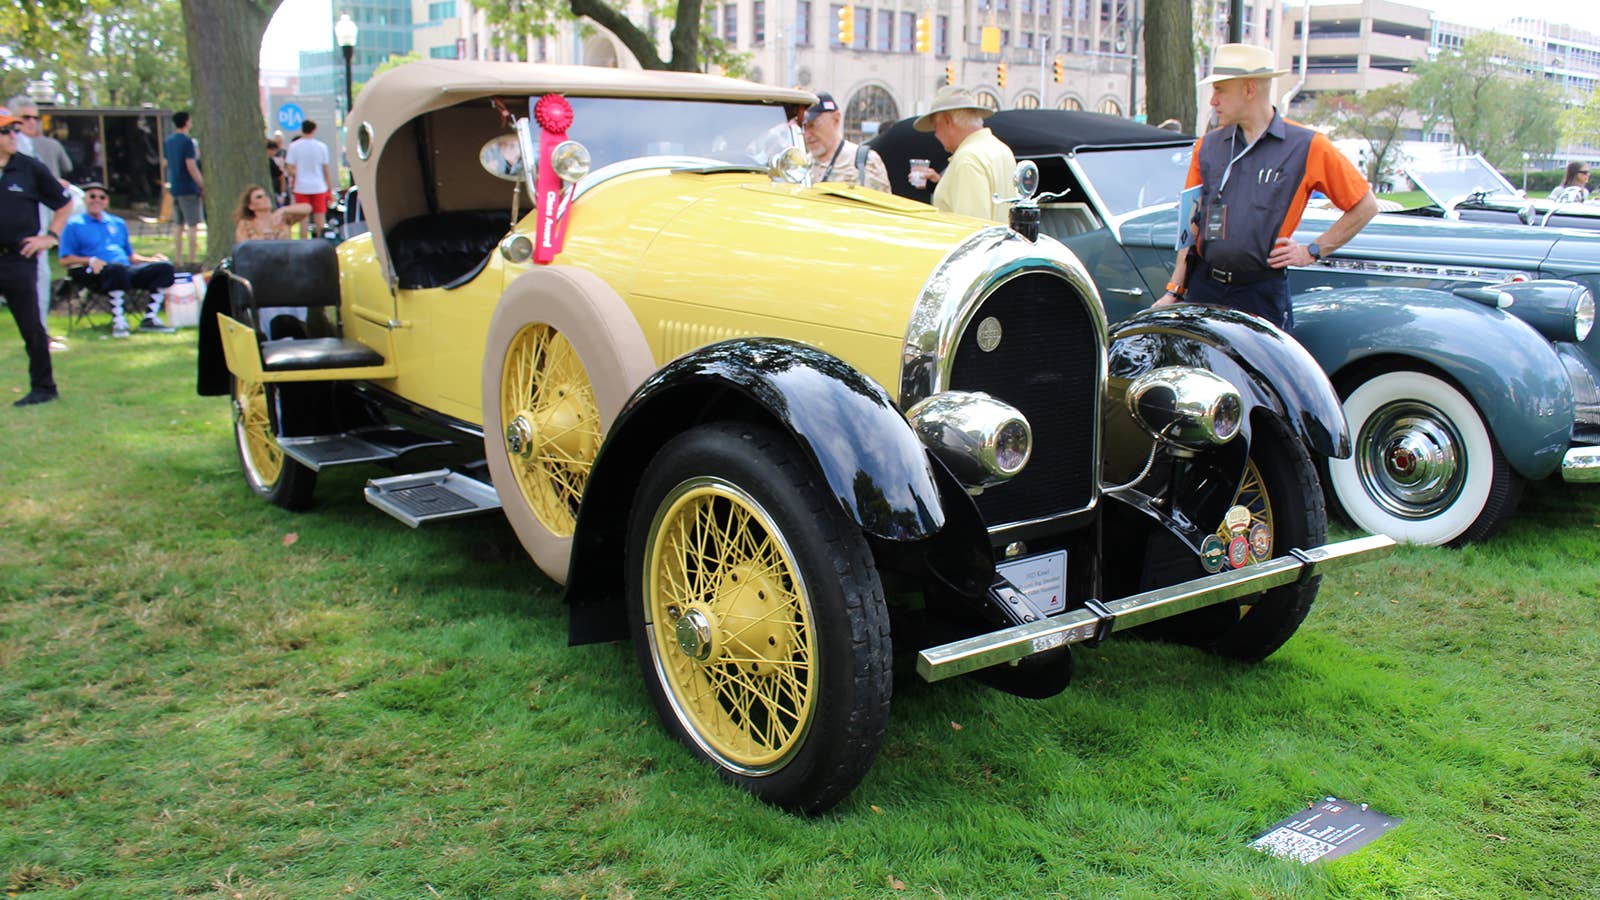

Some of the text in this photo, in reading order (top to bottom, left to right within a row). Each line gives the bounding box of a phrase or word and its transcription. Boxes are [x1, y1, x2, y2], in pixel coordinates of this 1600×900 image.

[279, 107, 303, 127] DIA
[542, 190, 556, 248] Class Award
